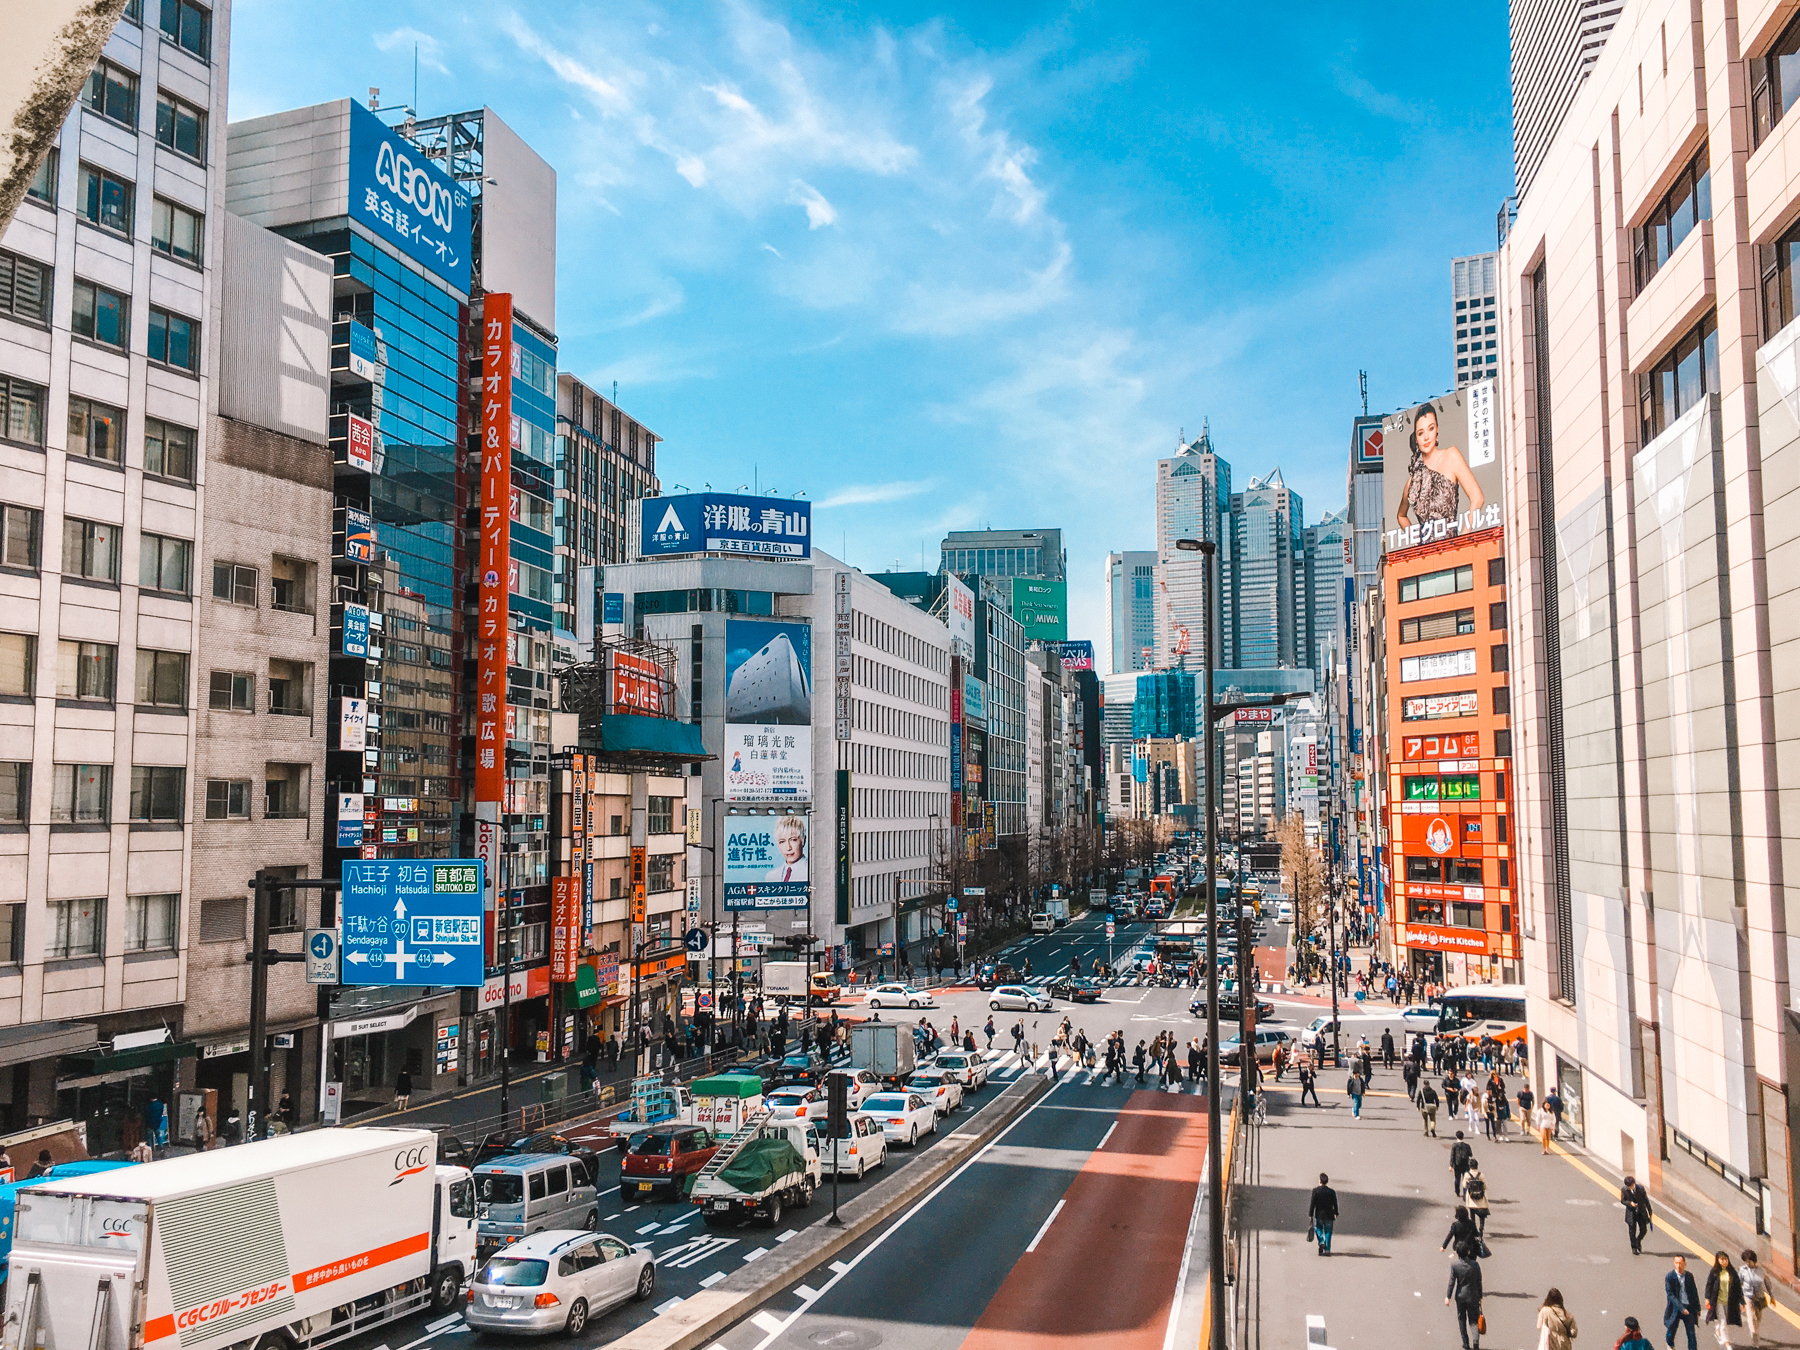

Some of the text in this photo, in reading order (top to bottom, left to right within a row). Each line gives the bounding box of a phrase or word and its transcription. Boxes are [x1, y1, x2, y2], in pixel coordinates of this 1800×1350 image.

[376, 141, 452, 233] AEON
[454, 189, 468, 211] 6F
[364, 187, 460, 268] 英会話イーオン
[1482, 386, 1490, 459] 世界の不動産を
[485, 318, 502, 566] カラオケ&パーティー
[703, 504, 808, 538] 洋服の青山
[1387, 503, 1501, 550] THEグローバル社
[651, 531, 690, 543] 洋服の青山
[347, 541, 370, 559] STW
[719, 539, 792, 553] 京王百貨店向い
[347, 605, 367, 619] AEON
[1035, 614, 1060, 624] MIWA
[347, 619, 366, 632] 英会話
[345, 630, 368, 643] イーオン
[480, 595, 499, 770] カラオケ歌広場
[344, 713, 364, 724] テイケイ
[1237, 709, 1270, 720] やまや
[743, 734, 795, 748] 瑠璃光院
[1407, 735, 1458, 758] アコム
[1464, 734, 1476, 745] 6F
[1461, 762, 1477, 770] アコム
[727, 832, 775, 847] AGAは、
[727, 847, 773, 862] 進行性。
[347, 865, 428, 883] 八王子 初台
[435, 867, 476, 883] 首都高
[351, 884, 430, 896] Hachioji Hatsudai
[435, 883, 477, 892] SHUTOKO EXP
[727, 886, 747, 895] AGA
[555, 881, 568, 926] カラオケ
[586, 864, 594, 928] EXCHANGE
[394, 923, 406, 934] 20
[435, 918, 478, 934] 新宿駅西口
[346, 934, 388, 947] Sendagaya
[435, 934, 460, 944] Shinjuku
[1439, 934, 1456, 944] First
[1456, 937, 1485, 949] Kitchen
[369, 954, 383, 963] 414
[417, 954, 431, 963] 414
[358, 1021, 387, 1030] SUIT SELECT
[697, 1106, 723, 1114] クイック
[394, 1145, 430, 1171] CGC
[102, 1217, 133, 1233] CGC
[305, 1256, 369, 1286] 世界中から良いものを
[177, 1282, 287, 1329] CGCグループセンター
